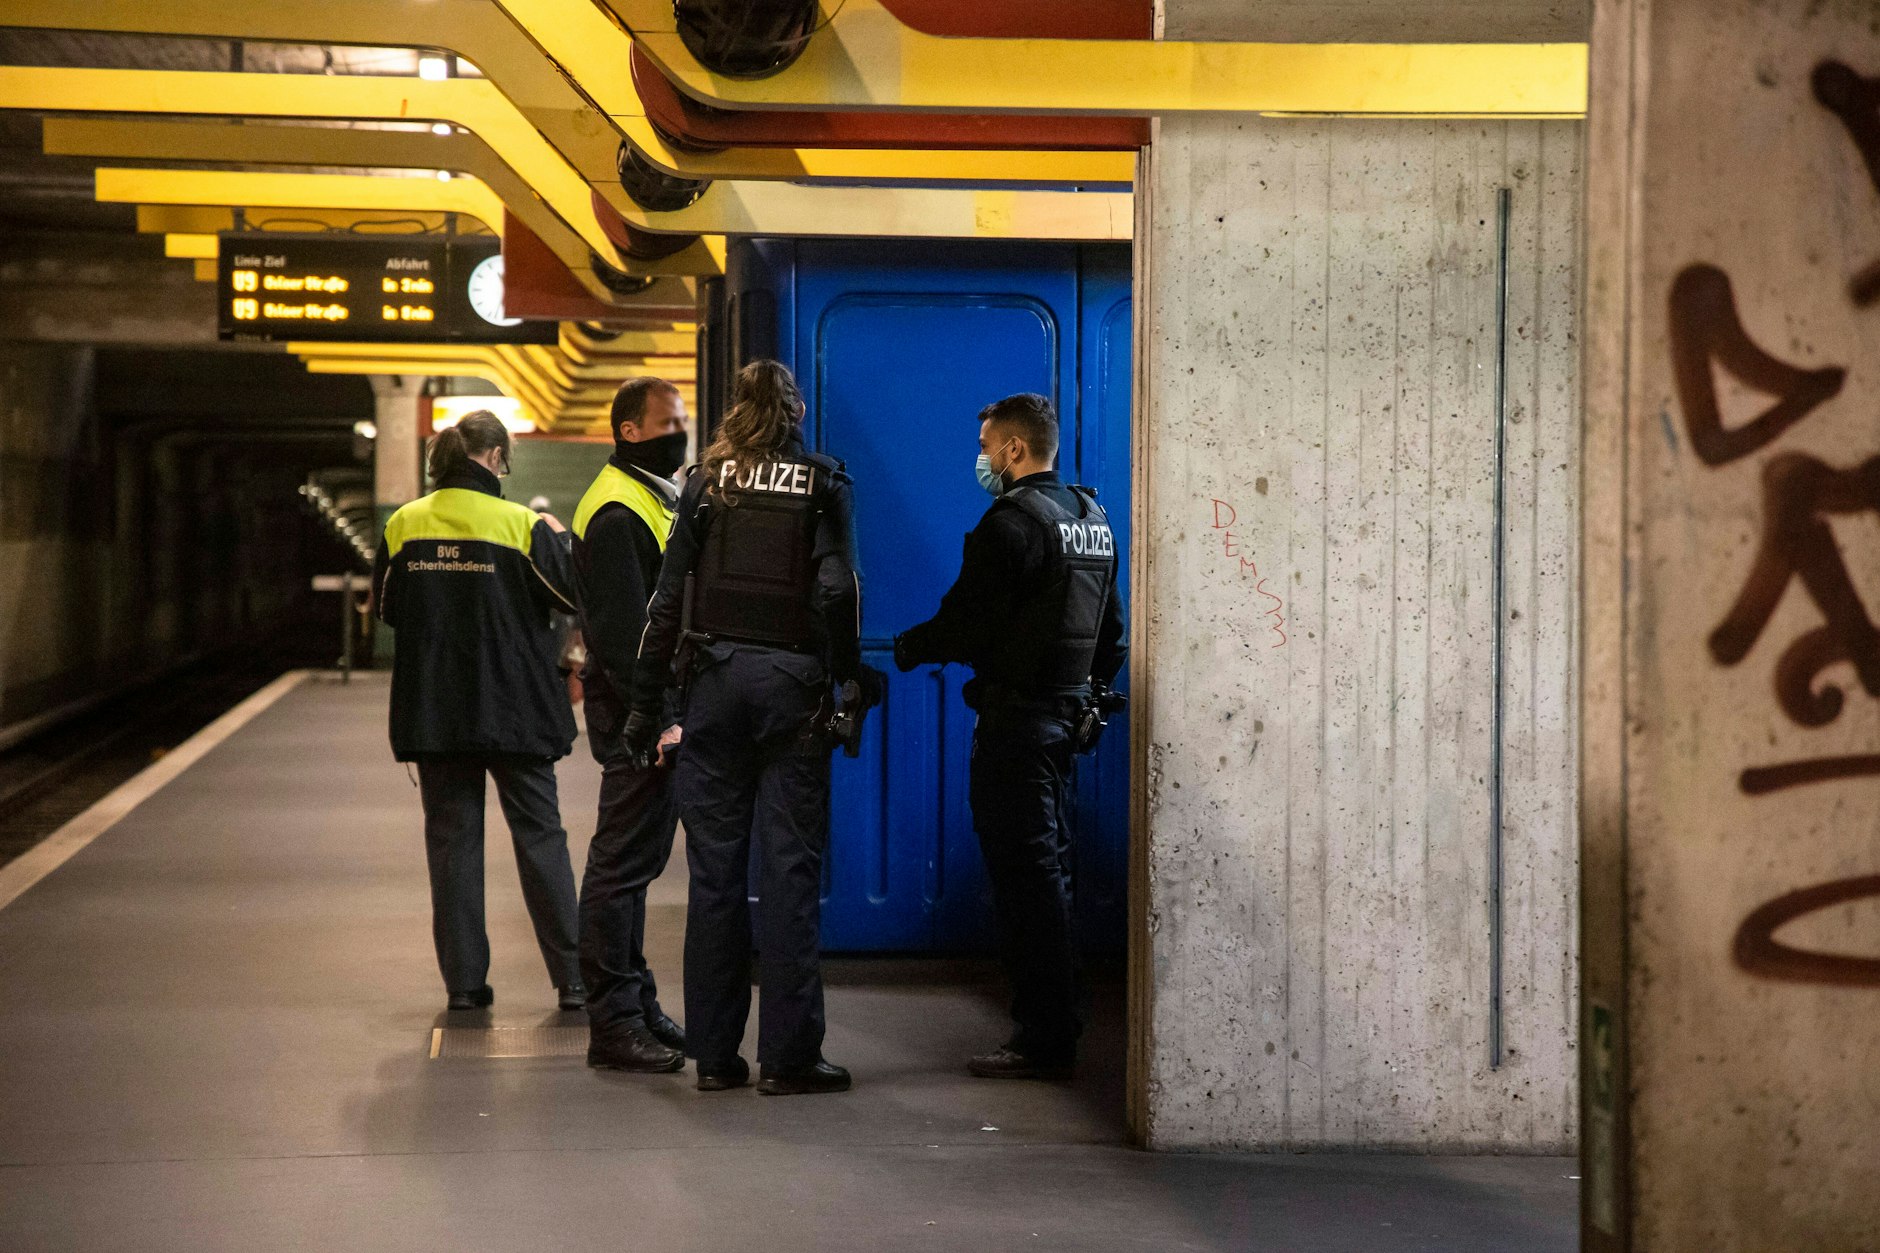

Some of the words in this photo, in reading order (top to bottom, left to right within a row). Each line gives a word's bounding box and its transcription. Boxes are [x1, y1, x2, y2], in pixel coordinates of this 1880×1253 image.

[386, 258, 430, 270] Abfahrt
[232, 270, 259, 292] U9
[232, 298, 259, 320] U9
[719, 460, 815, 495] POLIZEI
[1059, 523, 1114, 556] POLIZEI
[437, 545, 460, 559] BVG
[407, 560, 495, 573] Sicherheitsdienst
